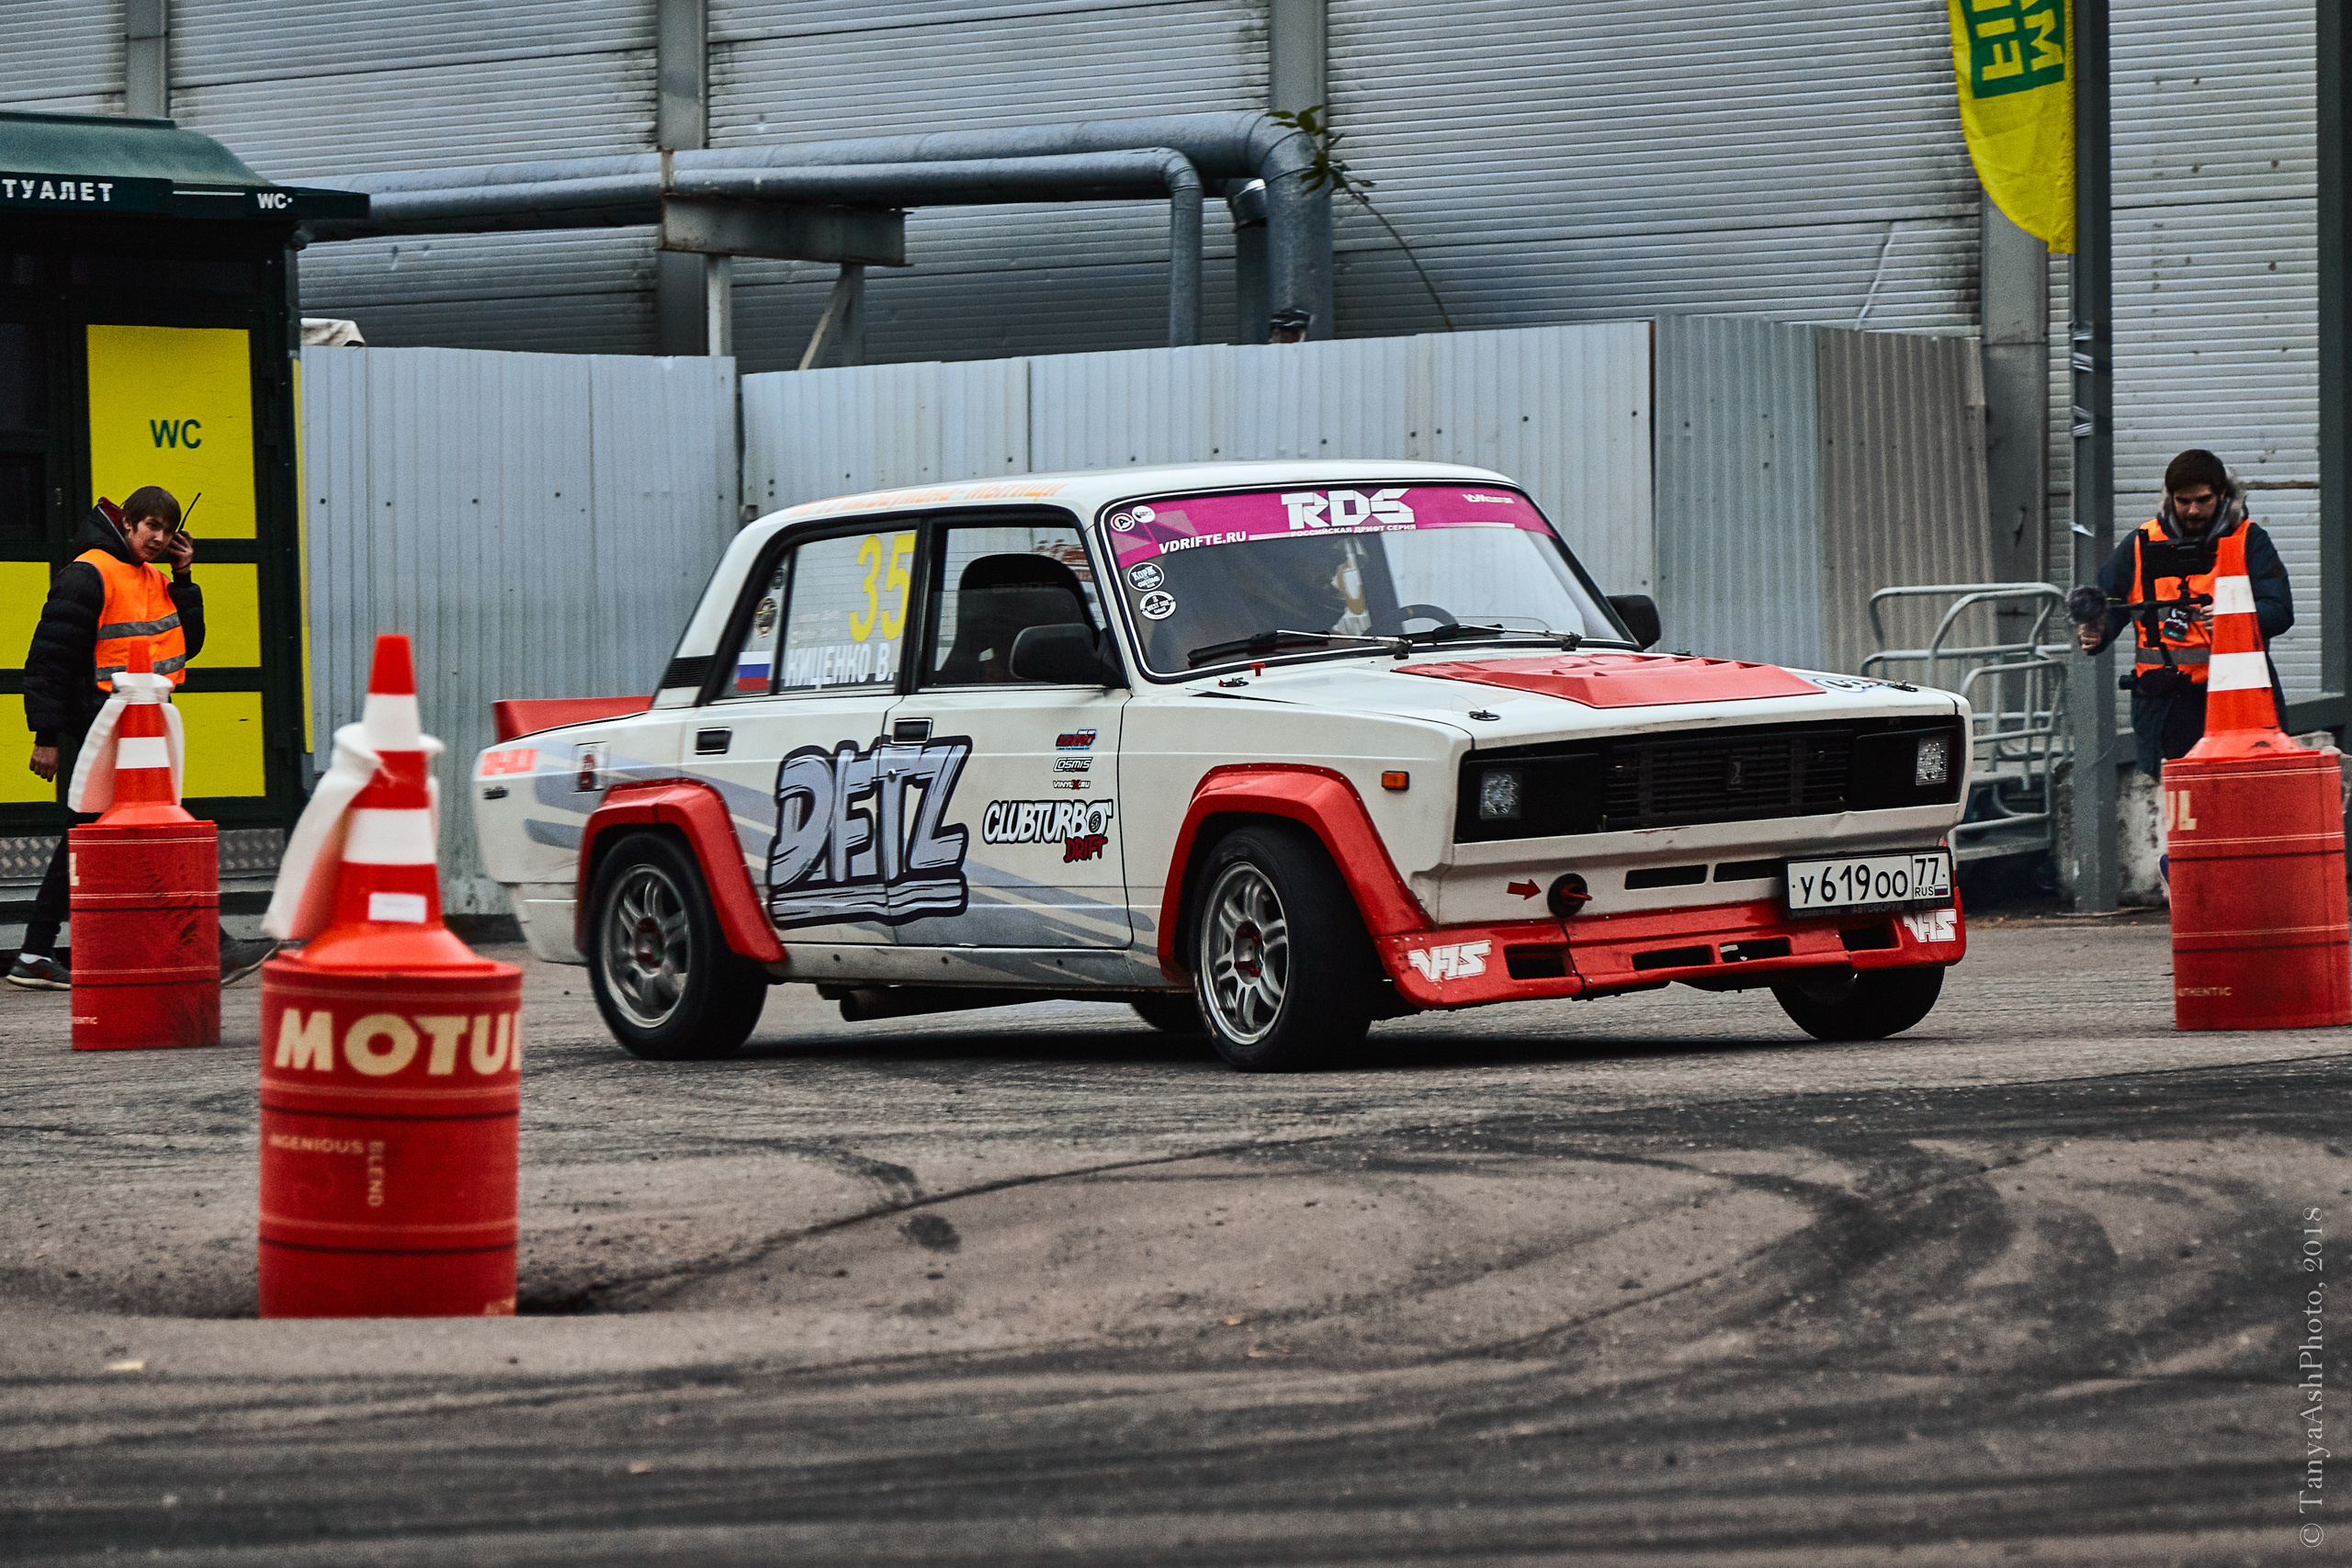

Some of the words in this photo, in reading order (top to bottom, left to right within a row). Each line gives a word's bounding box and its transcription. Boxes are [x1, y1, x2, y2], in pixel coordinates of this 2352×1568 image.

[1, 178, 114, 202] ТУАЛЕТ
[256, 192, 288, 209] WC
[149, 419, 203, 449] WC
[1280, 488, 1416, 530] RDS
[1159, 531, 1248, 555] VDRIFTE.RU
[1290, 526, 1352, 537] РОССИЙСКАЯ
[1353, 525, 1385, 534] ДРИФТ
[849, 533, 917, 642] 35
[1063, 833, 1109, 863] DRIFT
[1915, 857, 1939, 886] 77
[1915, 886, 1934, 897] RUS
[1851, 901, 1905, 915] АВТОФОРУМ
